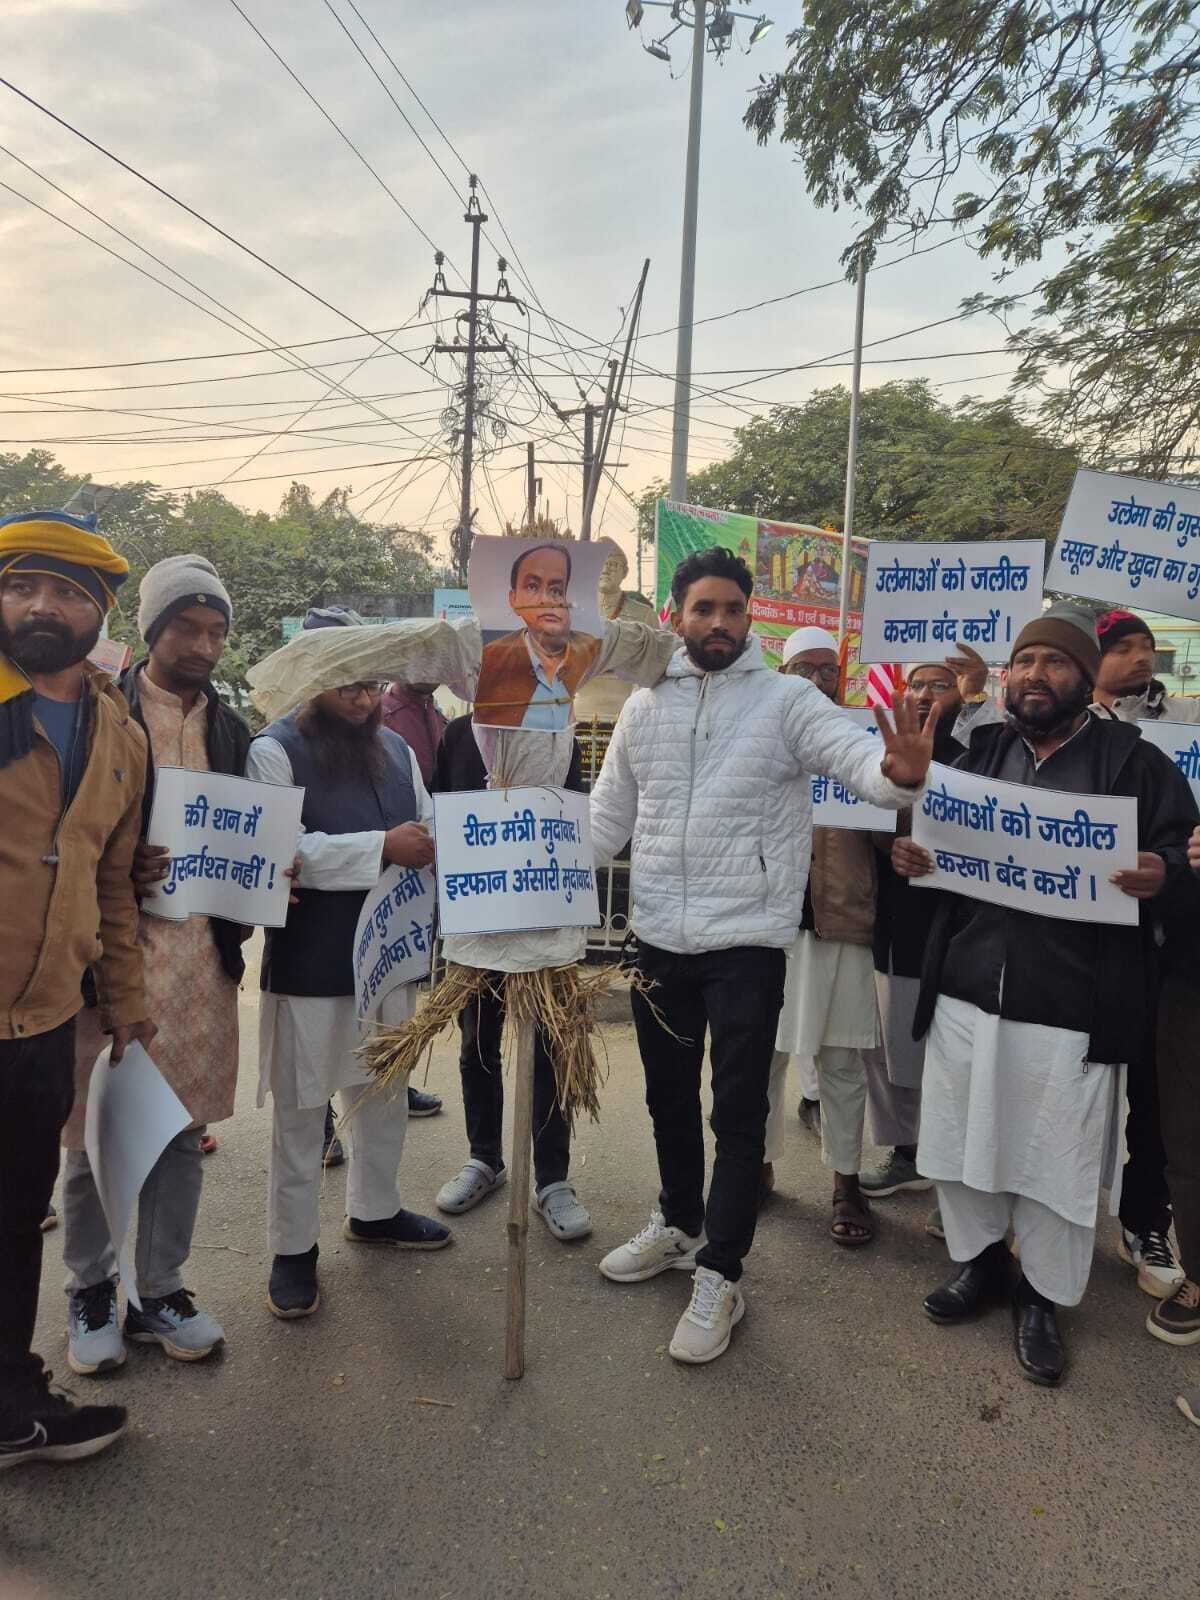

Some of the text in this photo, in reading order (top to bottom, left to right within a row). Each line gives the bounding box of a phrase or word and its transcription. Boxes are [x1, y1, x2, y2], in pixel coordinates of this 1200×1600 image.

[1108, 495, 1152, 528] उलेमा
[1152, 501, 1176, 532] की
[875, 555, 1031, 593] उलेमाओं को जलील
[1060, 539, 1098, 575] रसूल
[1096, 539, 1127, 571] और
[1127, 551, 1163, 588] खुदा
[1163, 559, 1187, 583] का
[884, 618, 927, 643] करना
[932, 609, 958, 645] बंद
[963, 609, 1001, 643] करों
[184, 794, 210, 828] की
[244, 805, 262, 837] में
[463, 813, 498, 846] रील
[501, 808, 536, 842] मंत्री
[922, 783, 1118, 852] उलेमाओं को जलील
[231, 855, 266, 890] नहीं
[445, 869, 507, 900] इरफान
[512, 858, 559, 892] अंसारी
[934, 848, 990, 882] करना
[995, 855, 1027, 891] बंद
[1032, 866, 1081, 900] करों
[373, 893, 394, 939] तुम
[391, 868, 425, 907] मंत्री
[368, 936, 413, 998] इस्तीफा
[409, 920, 427, 953] दे
